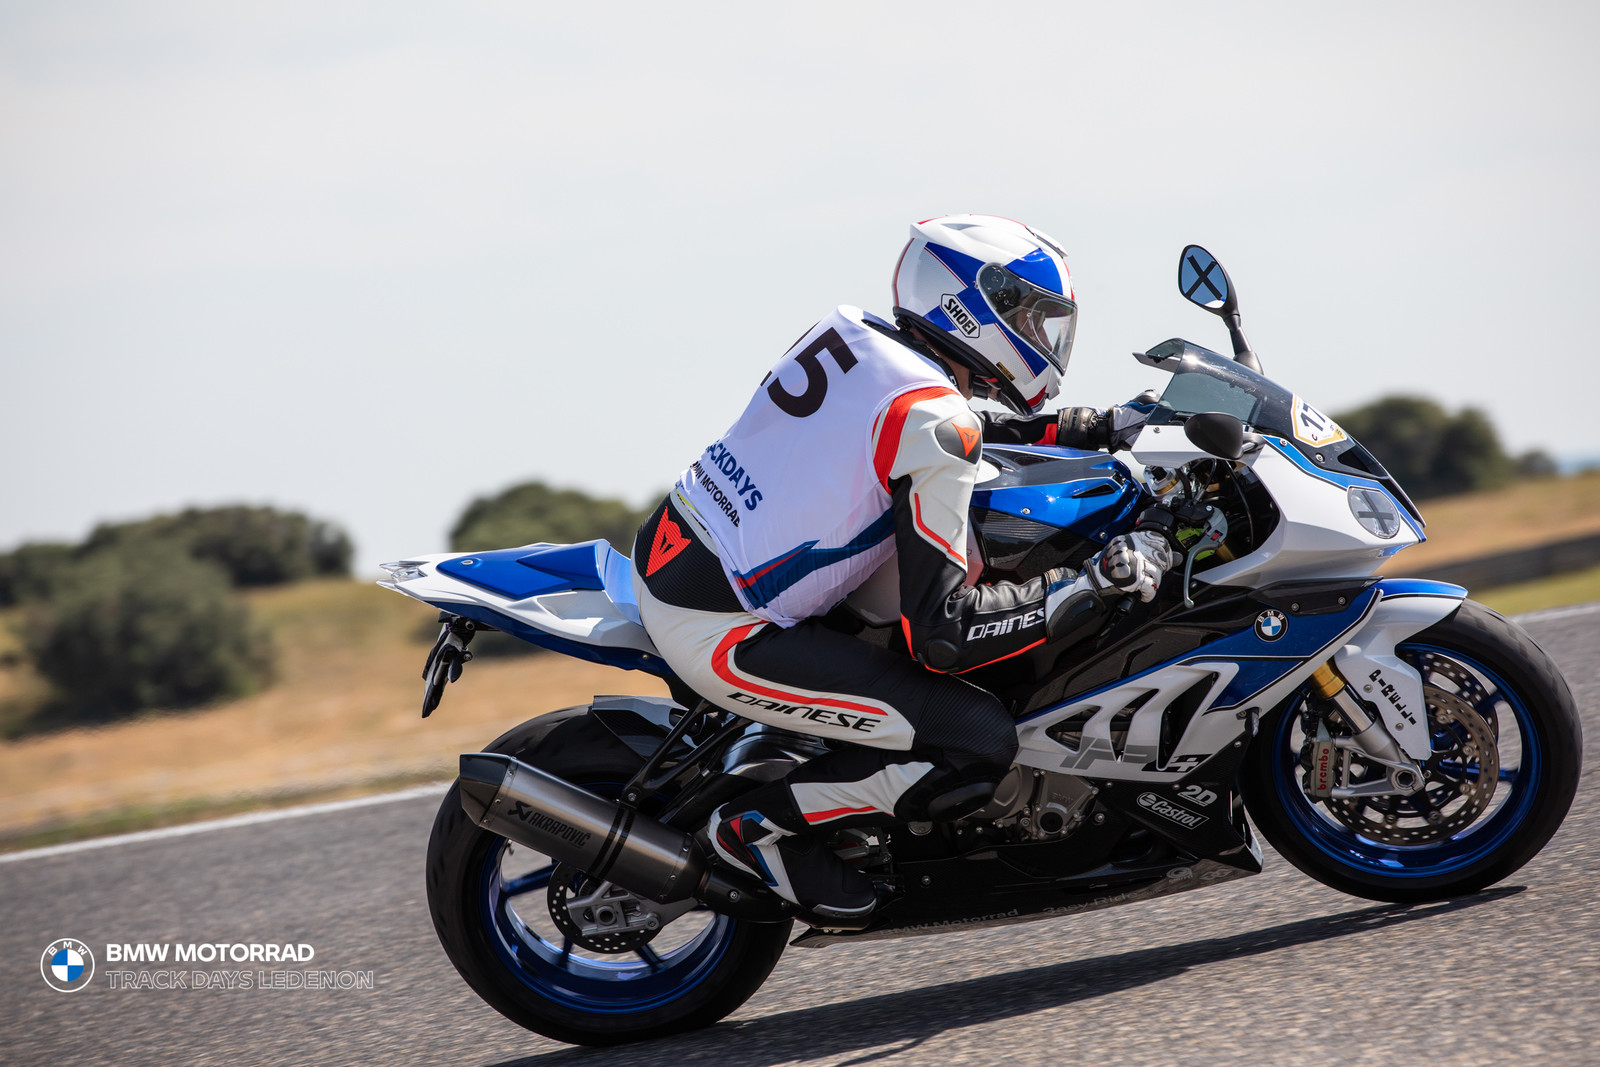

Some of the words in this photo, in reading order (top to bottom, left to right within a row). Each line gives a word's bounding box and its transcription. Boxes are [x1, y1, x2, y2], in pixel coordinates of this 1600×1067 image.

[944, 298, 978, 336] SHOEI
[760, 320, 859, 418] 5
[966, 607, 1046, 641] DAINES
[726, 692, 881, 733] DAINESE
[1369, 669, 1417, 725] PIRELLI
[1317, 748, 1329, 790] brembo
[1151, 801, 1202, 828] Castrol
[1178, 785, 1217, 807] 2D
[929, 908, 1019, 929] Motorrad
